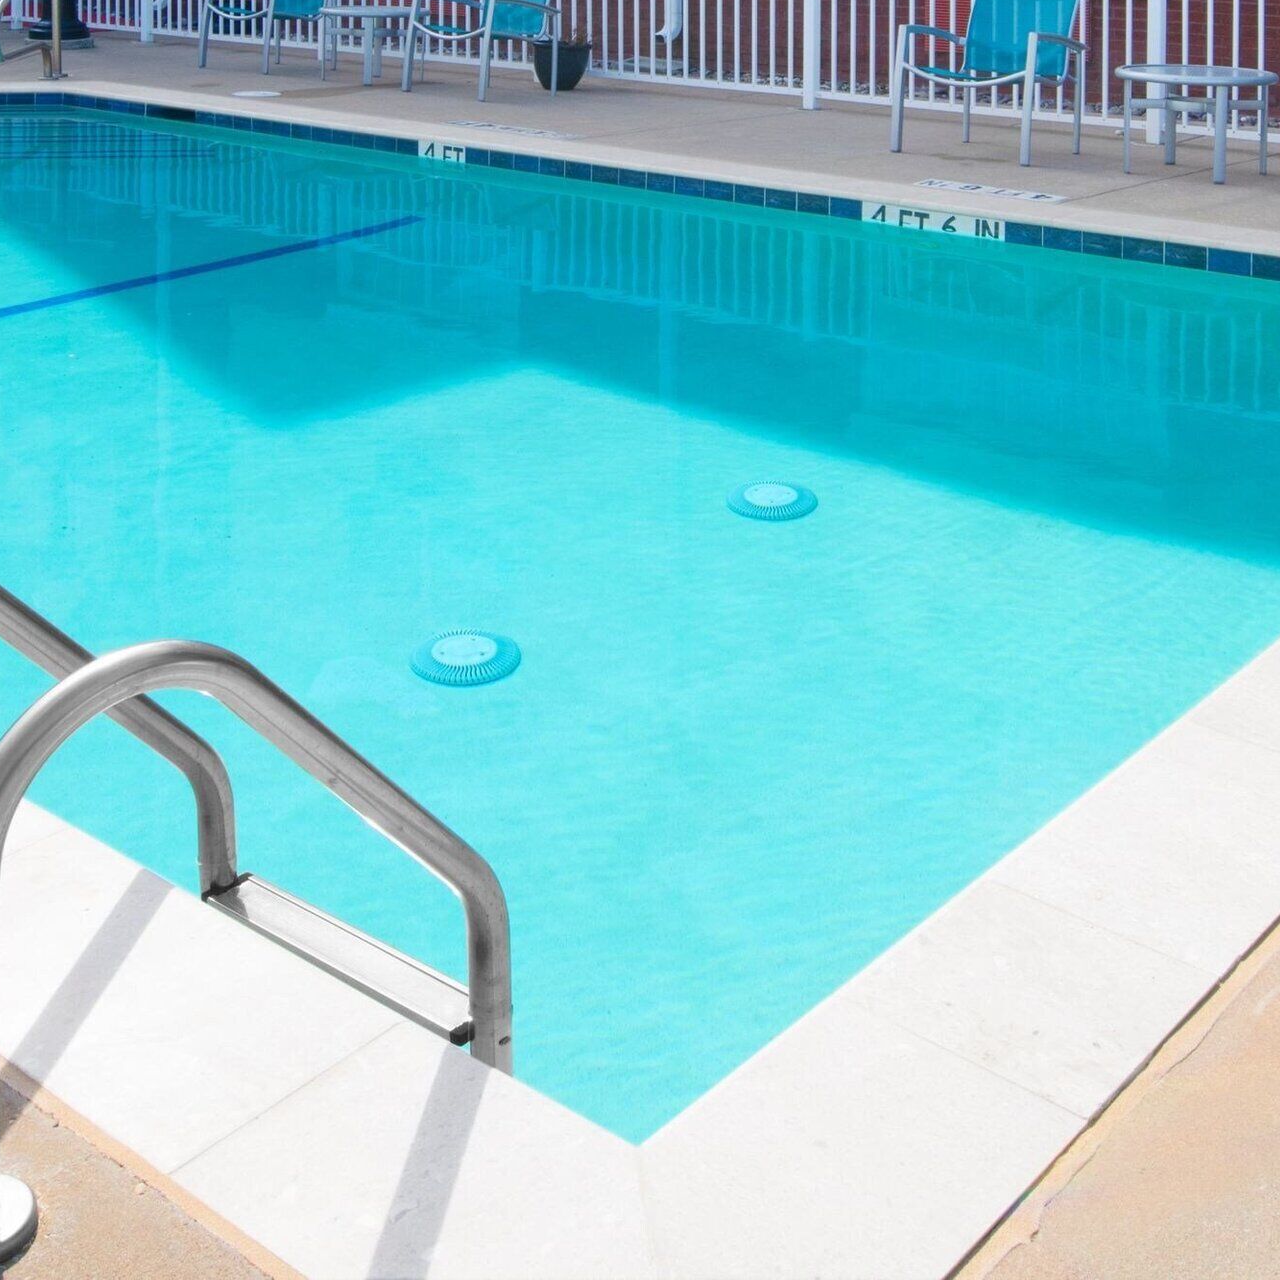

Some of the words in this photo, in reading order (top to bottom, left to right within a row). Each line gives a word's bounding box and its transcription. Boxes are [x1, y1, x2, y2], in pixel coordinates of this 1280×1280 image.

[424, 142, 435, 158] 4
[443, 145, 464, 162] FT
[871, 204, 886, 223] 4
[898, 208, 930, 230] FT
[941, 215, 957, 232] 6
[975, 218, 1000, 239] IN
